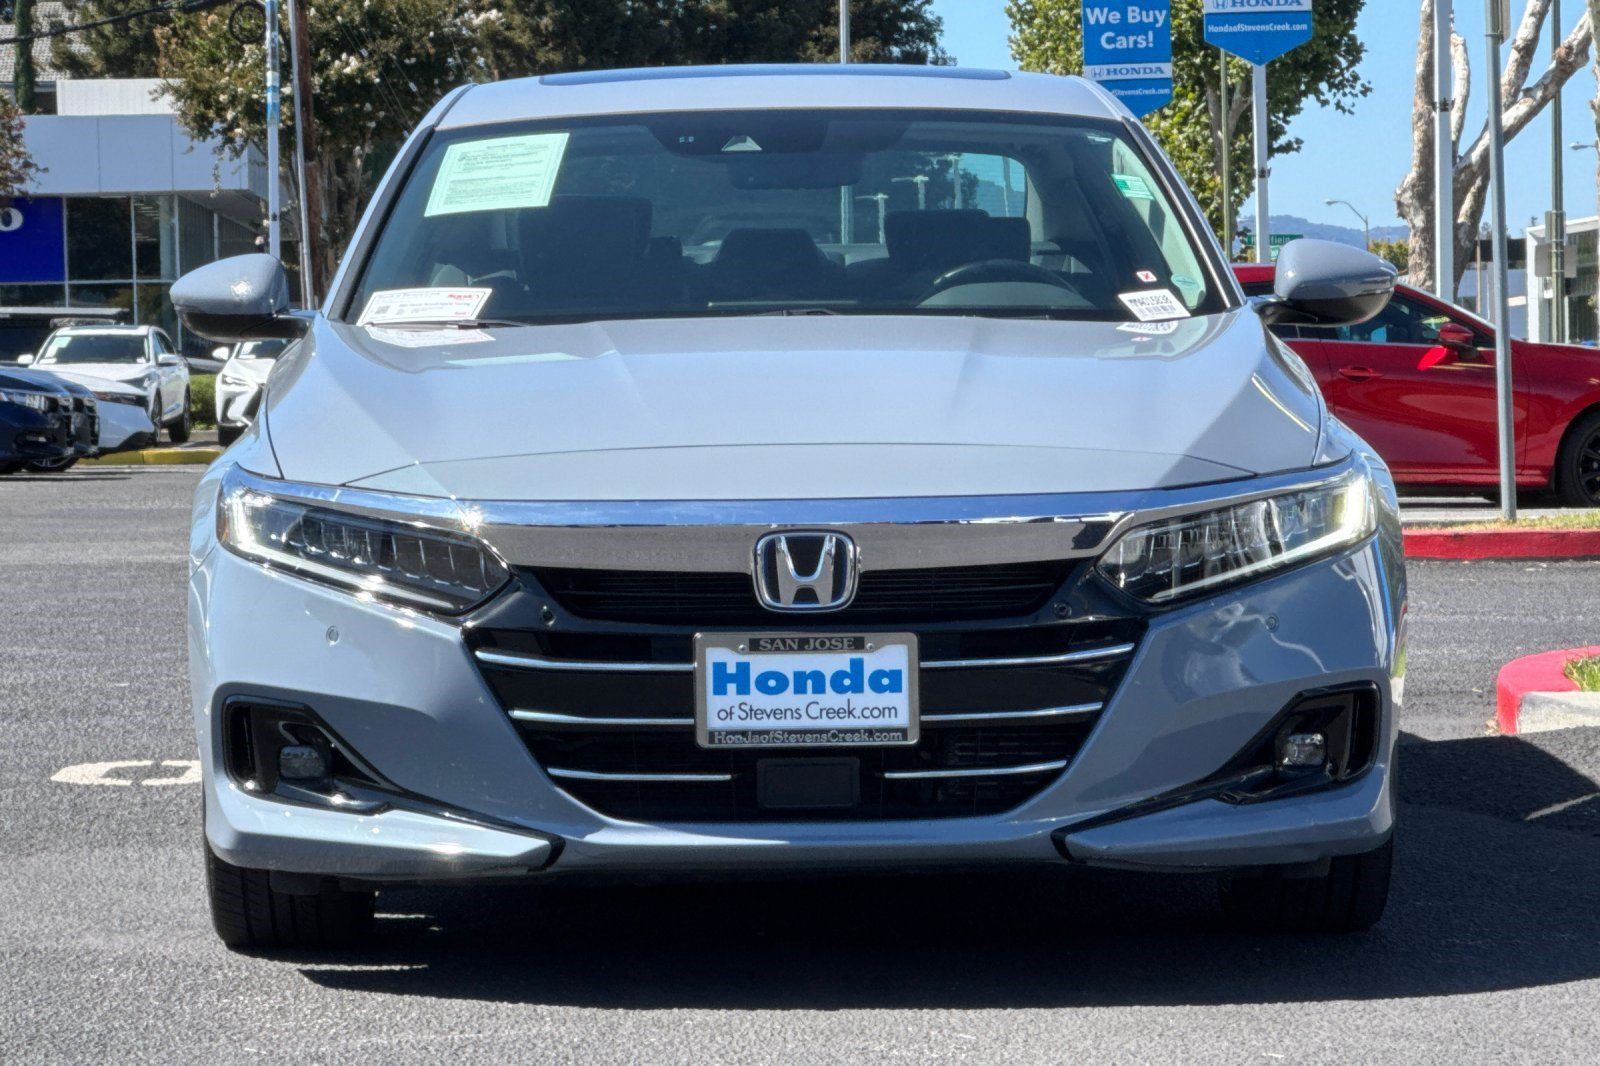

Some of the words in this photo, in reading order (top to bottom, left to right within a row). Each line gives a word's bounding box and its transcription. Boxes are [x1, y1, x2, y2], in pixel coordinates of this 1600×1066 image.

[1231, 0, 1303, 8] HONDA
[1086, 7, 1121, 25] We
[1127, 5, 1166, 27] Buy
[1208, 22, 1308, 33] HondaofStevensCreek.com
[1100, 31, 1154, 50] Cars!
[1106, 66, 1165, 76] HONDA
[759, 637, 799, 650] SAN
[804, 637, 855, 650] JOSE
[712, 657, 903, 696] Honda
[717, 705, 735, 721] of
[738, 702, 802, 721] Stevens
[805, 698, 898, 720] Creek.com
